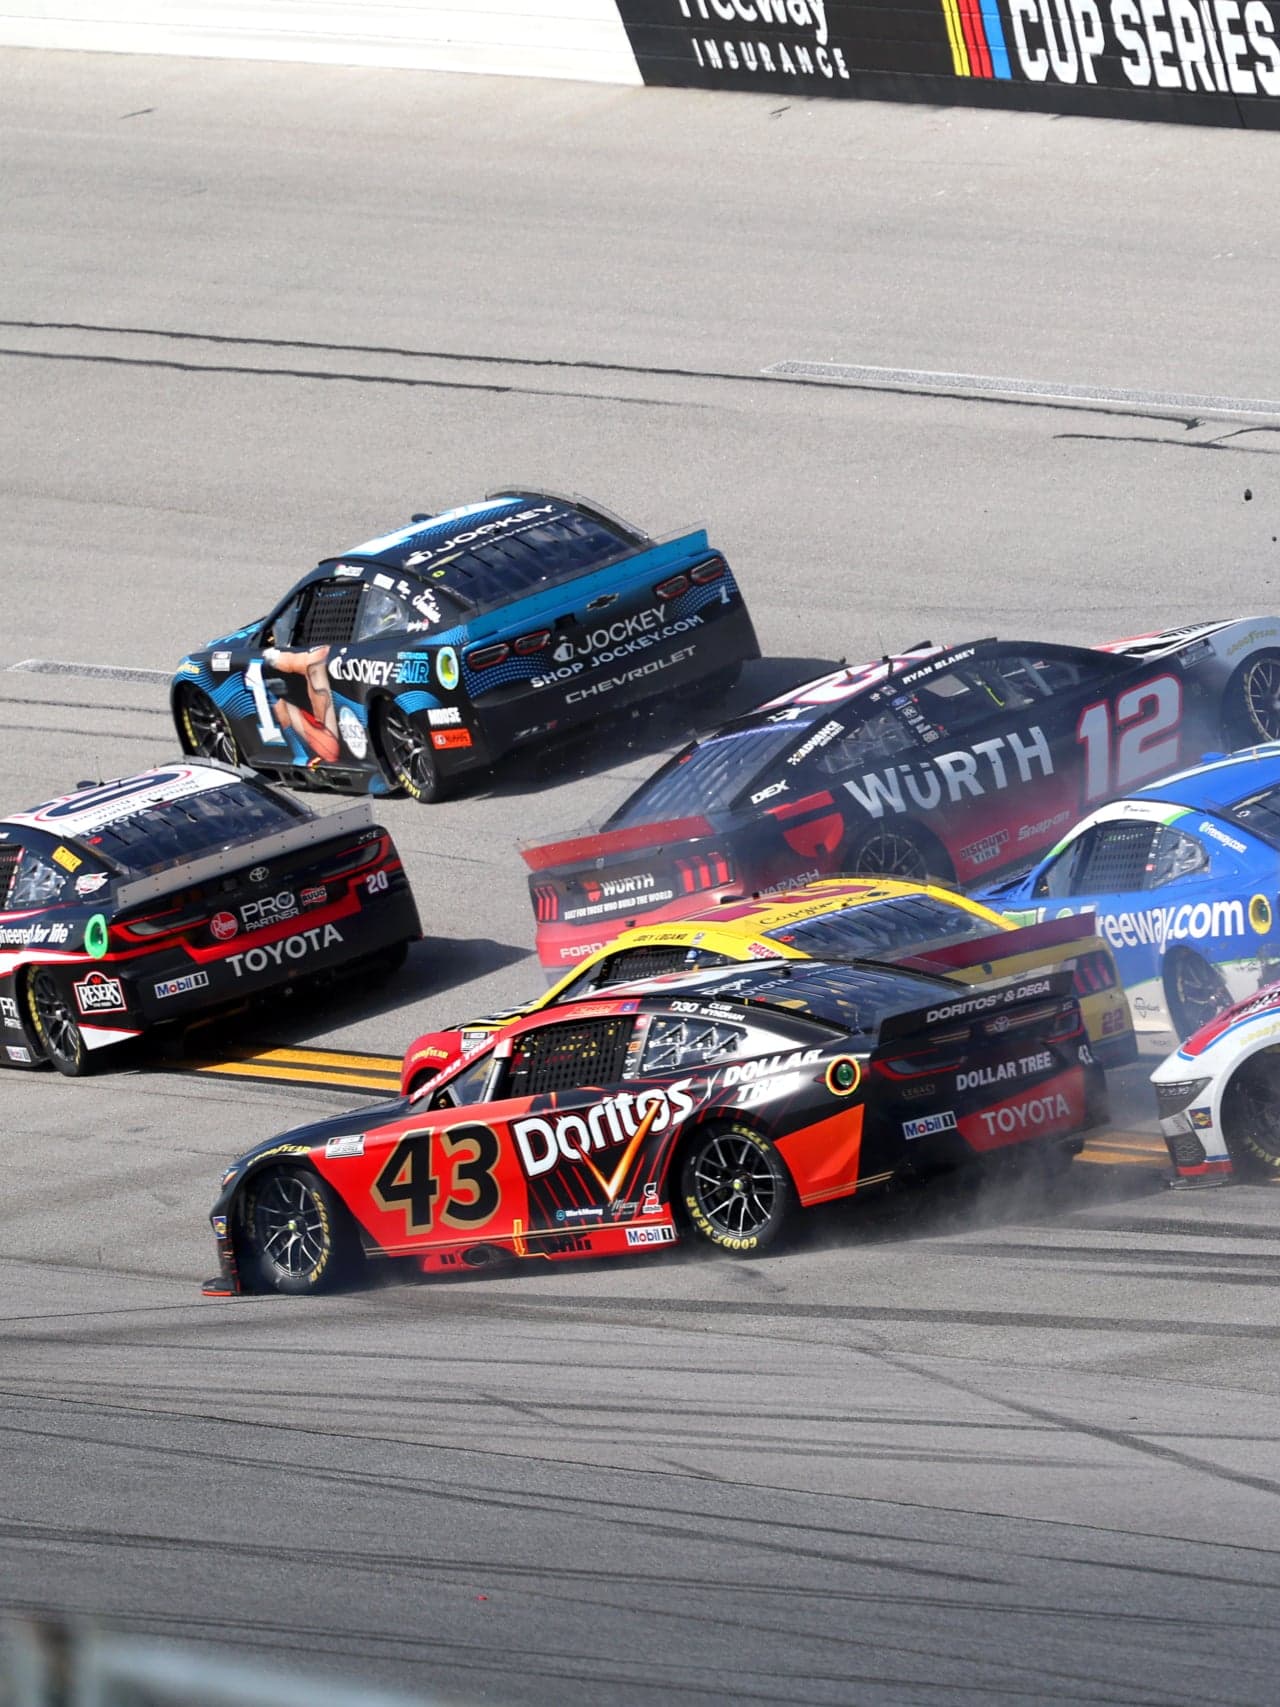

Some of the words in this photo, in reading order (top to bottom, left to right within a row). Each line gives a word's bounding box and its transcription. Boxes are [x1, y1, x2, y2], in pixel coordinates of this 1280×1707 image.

[691, 38, 850, 79] INSURANCE
[1010, 0, 1104, 85] CUP
[577, 604, 668, 656] JOCKEY
[342, 658, 394, 686] JOCKEY
[530, 662, 584, 689] SHOP
[591, 615, 704, 669] JOCKEY.COM
[902, 666, 933, 685] RYAN
[934, 648, 976, 670] BLANEY
[565, 645, 697, 704] CHEVROLET
[244, 658, 288, 746] 1
[1077, 672, 1185, 802] 12
[750, 779, 790, 805] DEX
[960, 829, 1009, 858] DISCOUNT
[366, 870, 389, 894] 20
[240, 890, 296, 923] PRO
[245, 907, 300, 932] PARTNER
[1080, 900, 1245, 955] reeway.com
[225, 924, 344, 977] TOYOTA
[748, 942, 783, 958] DISCO
[156, 976, 193, 998] Mobil
[926, 994, 998, 1024] DORITOS
[1004, 989, 1016, 1002] &
[1016, 980, 1051, 998] DEGA
[722, 1049, 824, 1088] DOLLAR
[737, 1071, 801, 1103] TR
[956, 1064, 1017, 1092] DOLLAR
[1019, 1051, 1052, 1073] TREE
[513, 1078, 695, 1177] Doritos
[904, 1117, 942, 1138] Mobil
[980, 1093, 1071, 1136] TOYOTA
[370, 1120, 501, 1237] 43
[628, 1228, 661, 1244] Mobil
